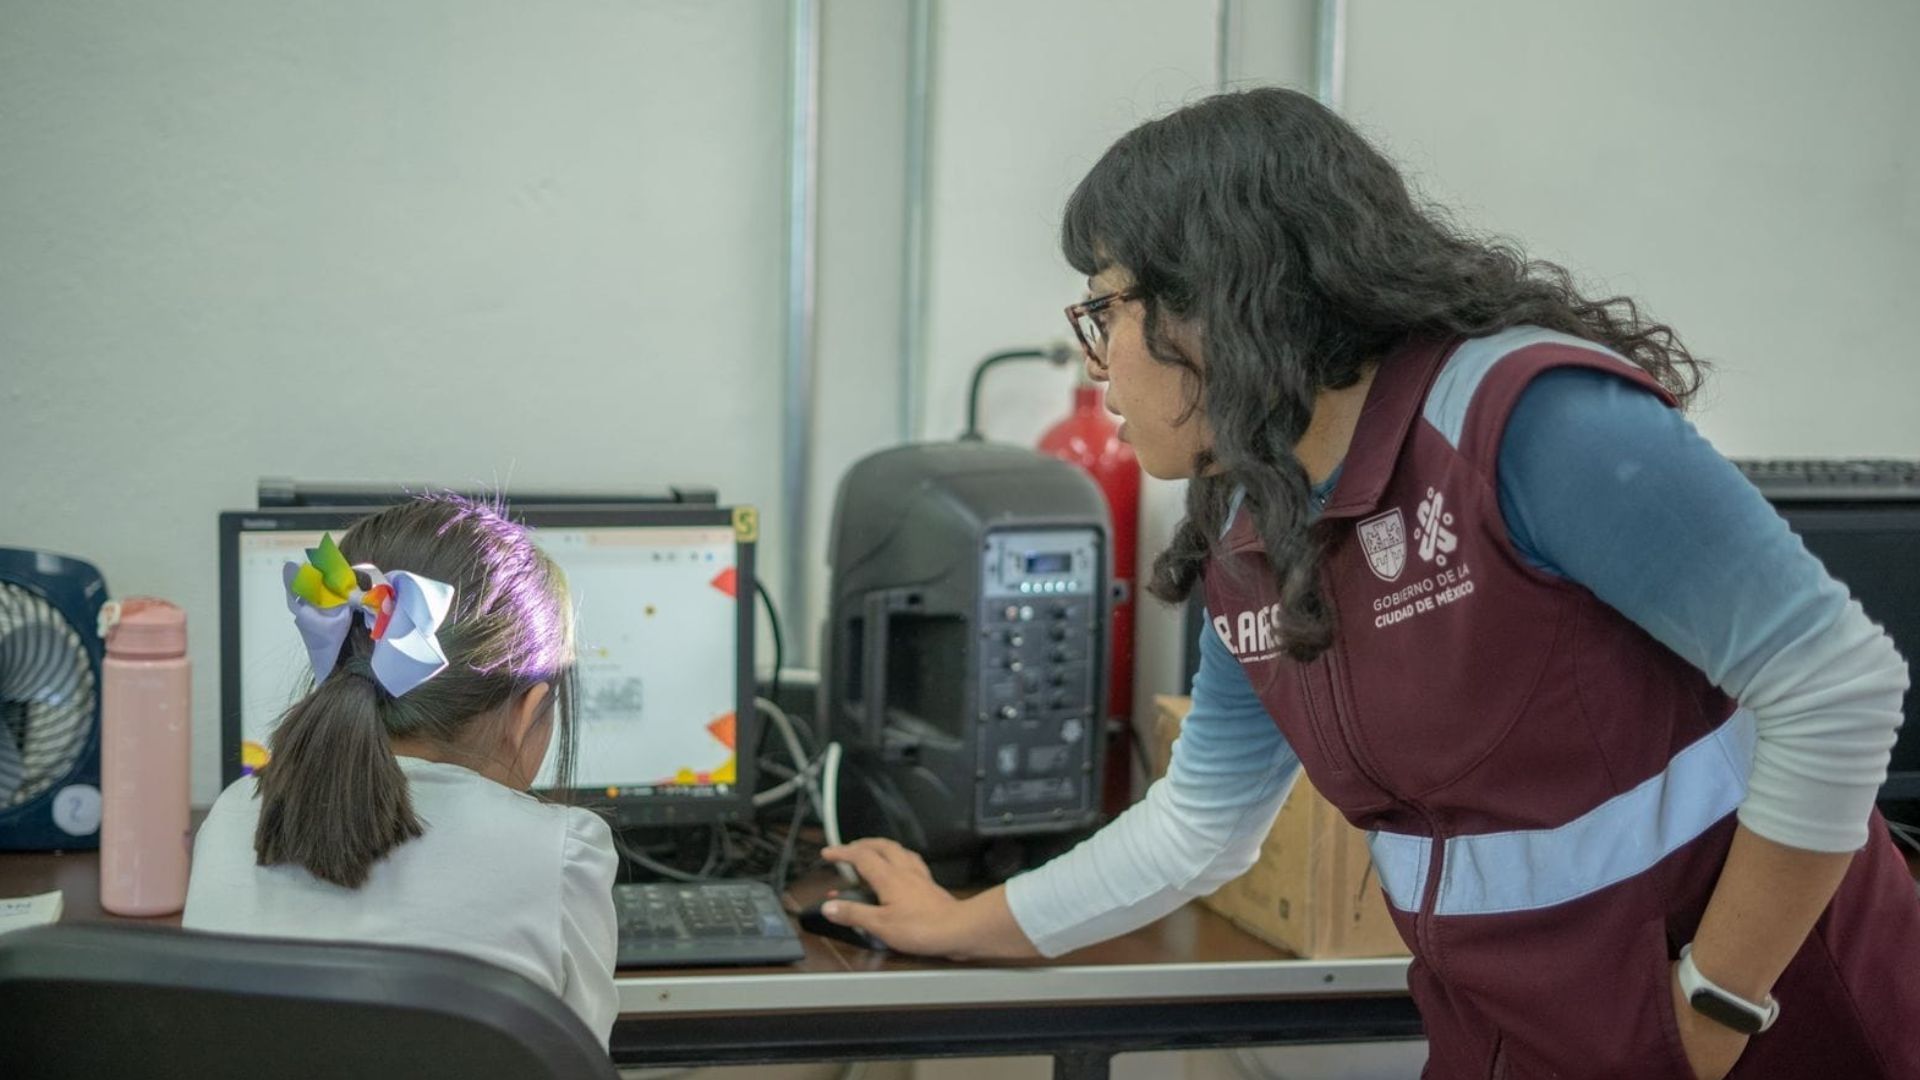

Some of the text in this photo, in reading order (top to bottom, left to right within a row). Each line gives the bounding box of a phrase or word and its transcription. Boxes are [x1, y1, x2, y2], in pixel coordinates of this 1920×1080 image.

[1373, 563, 1470, 611] GOBIERNO DE LA
[1375, 580, 1475, 628] CIUDAD DE MÉXICO
